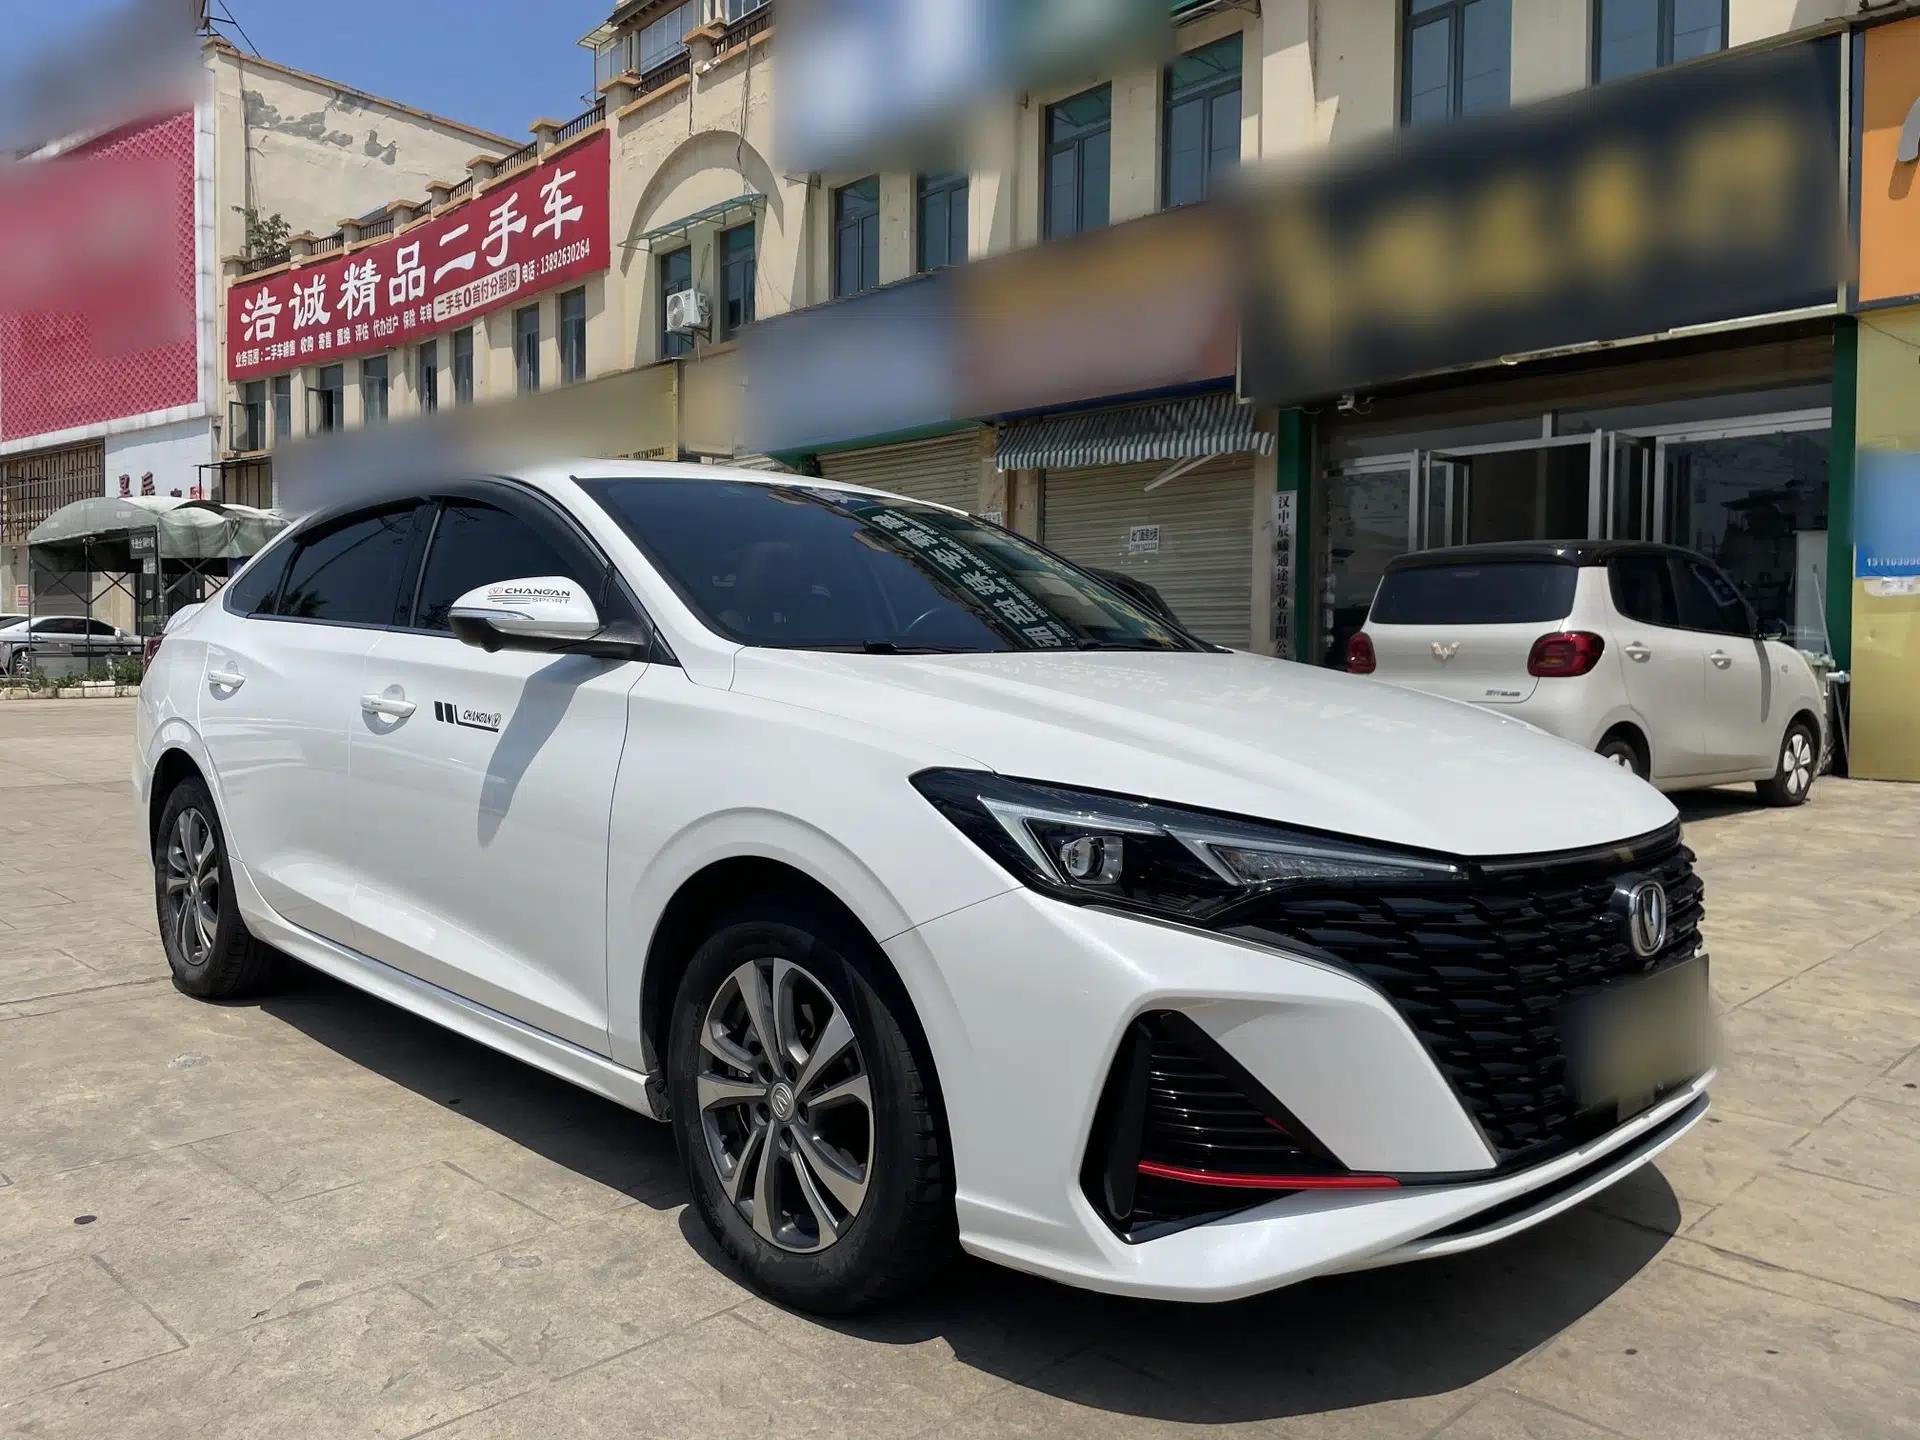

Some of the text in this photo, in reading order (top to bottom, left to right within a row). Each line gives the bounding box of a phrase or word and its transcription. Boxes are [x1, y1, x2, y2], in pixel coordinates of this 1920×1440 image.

[240, 168, 584, 342] 浩诚精品二手车
[437, 267, 517, 316] 二手车0首付分期购
[300, 333, 314, 354] 收购
[355, 320, 369, 342] 评估
[373, 314, 399, 338] 代办过户
[403, 310, 416, 329] 保险
[504, 587, 571, 597] CHANGAN
[532, 596, 571, 604] SPORT
[463, 710, 492, 725] CHANGAN
